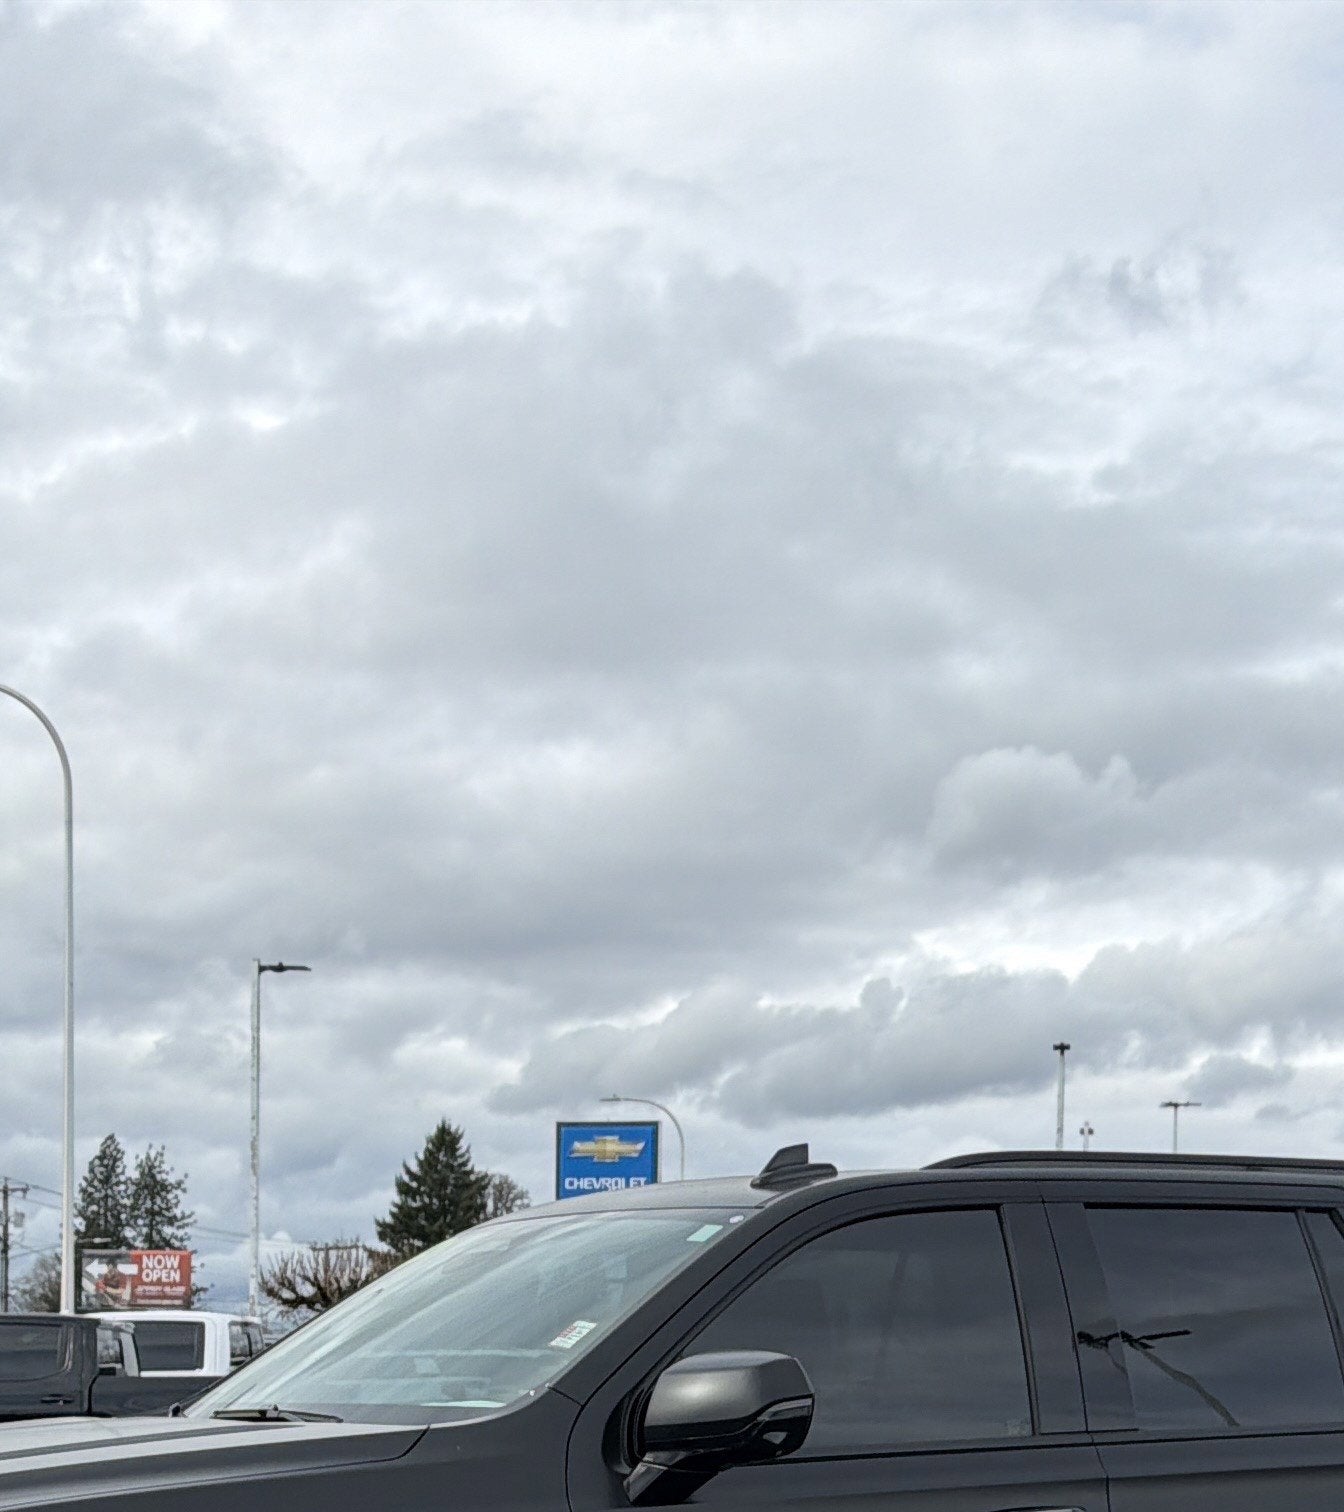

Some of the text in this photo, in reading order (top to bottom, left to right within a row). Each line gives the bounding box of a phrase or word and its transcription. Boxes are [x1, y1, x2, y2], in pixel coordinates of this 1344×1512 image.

[564, 1177, 647, 1190] CHEVROLET
[142, 1254, 181, 1269] NOW
[141, 1268, 181, 1283] OPEN
